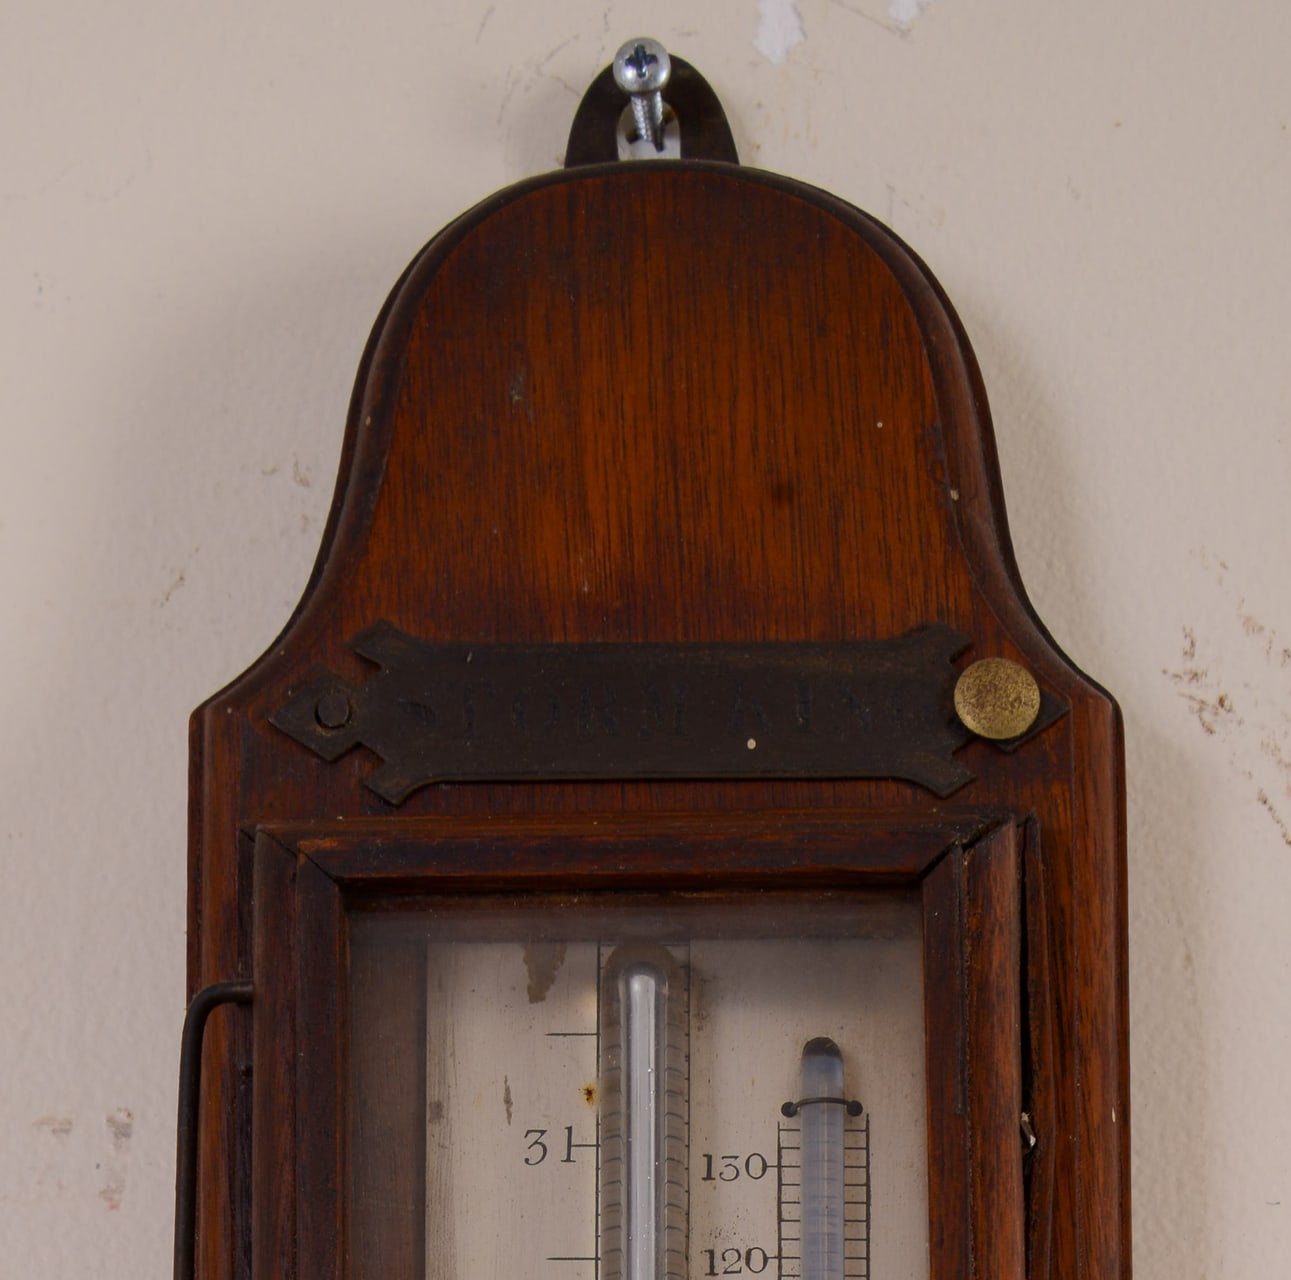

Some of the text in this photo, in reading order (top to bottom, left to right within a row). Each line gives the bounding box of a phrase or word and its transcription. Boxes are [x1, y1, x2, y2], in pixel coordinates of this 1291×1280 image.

[523, 1126, 576, 1165] 31
[702, 1153, 767, 1181] 130
[703, 1246, 768, 1276] 120
